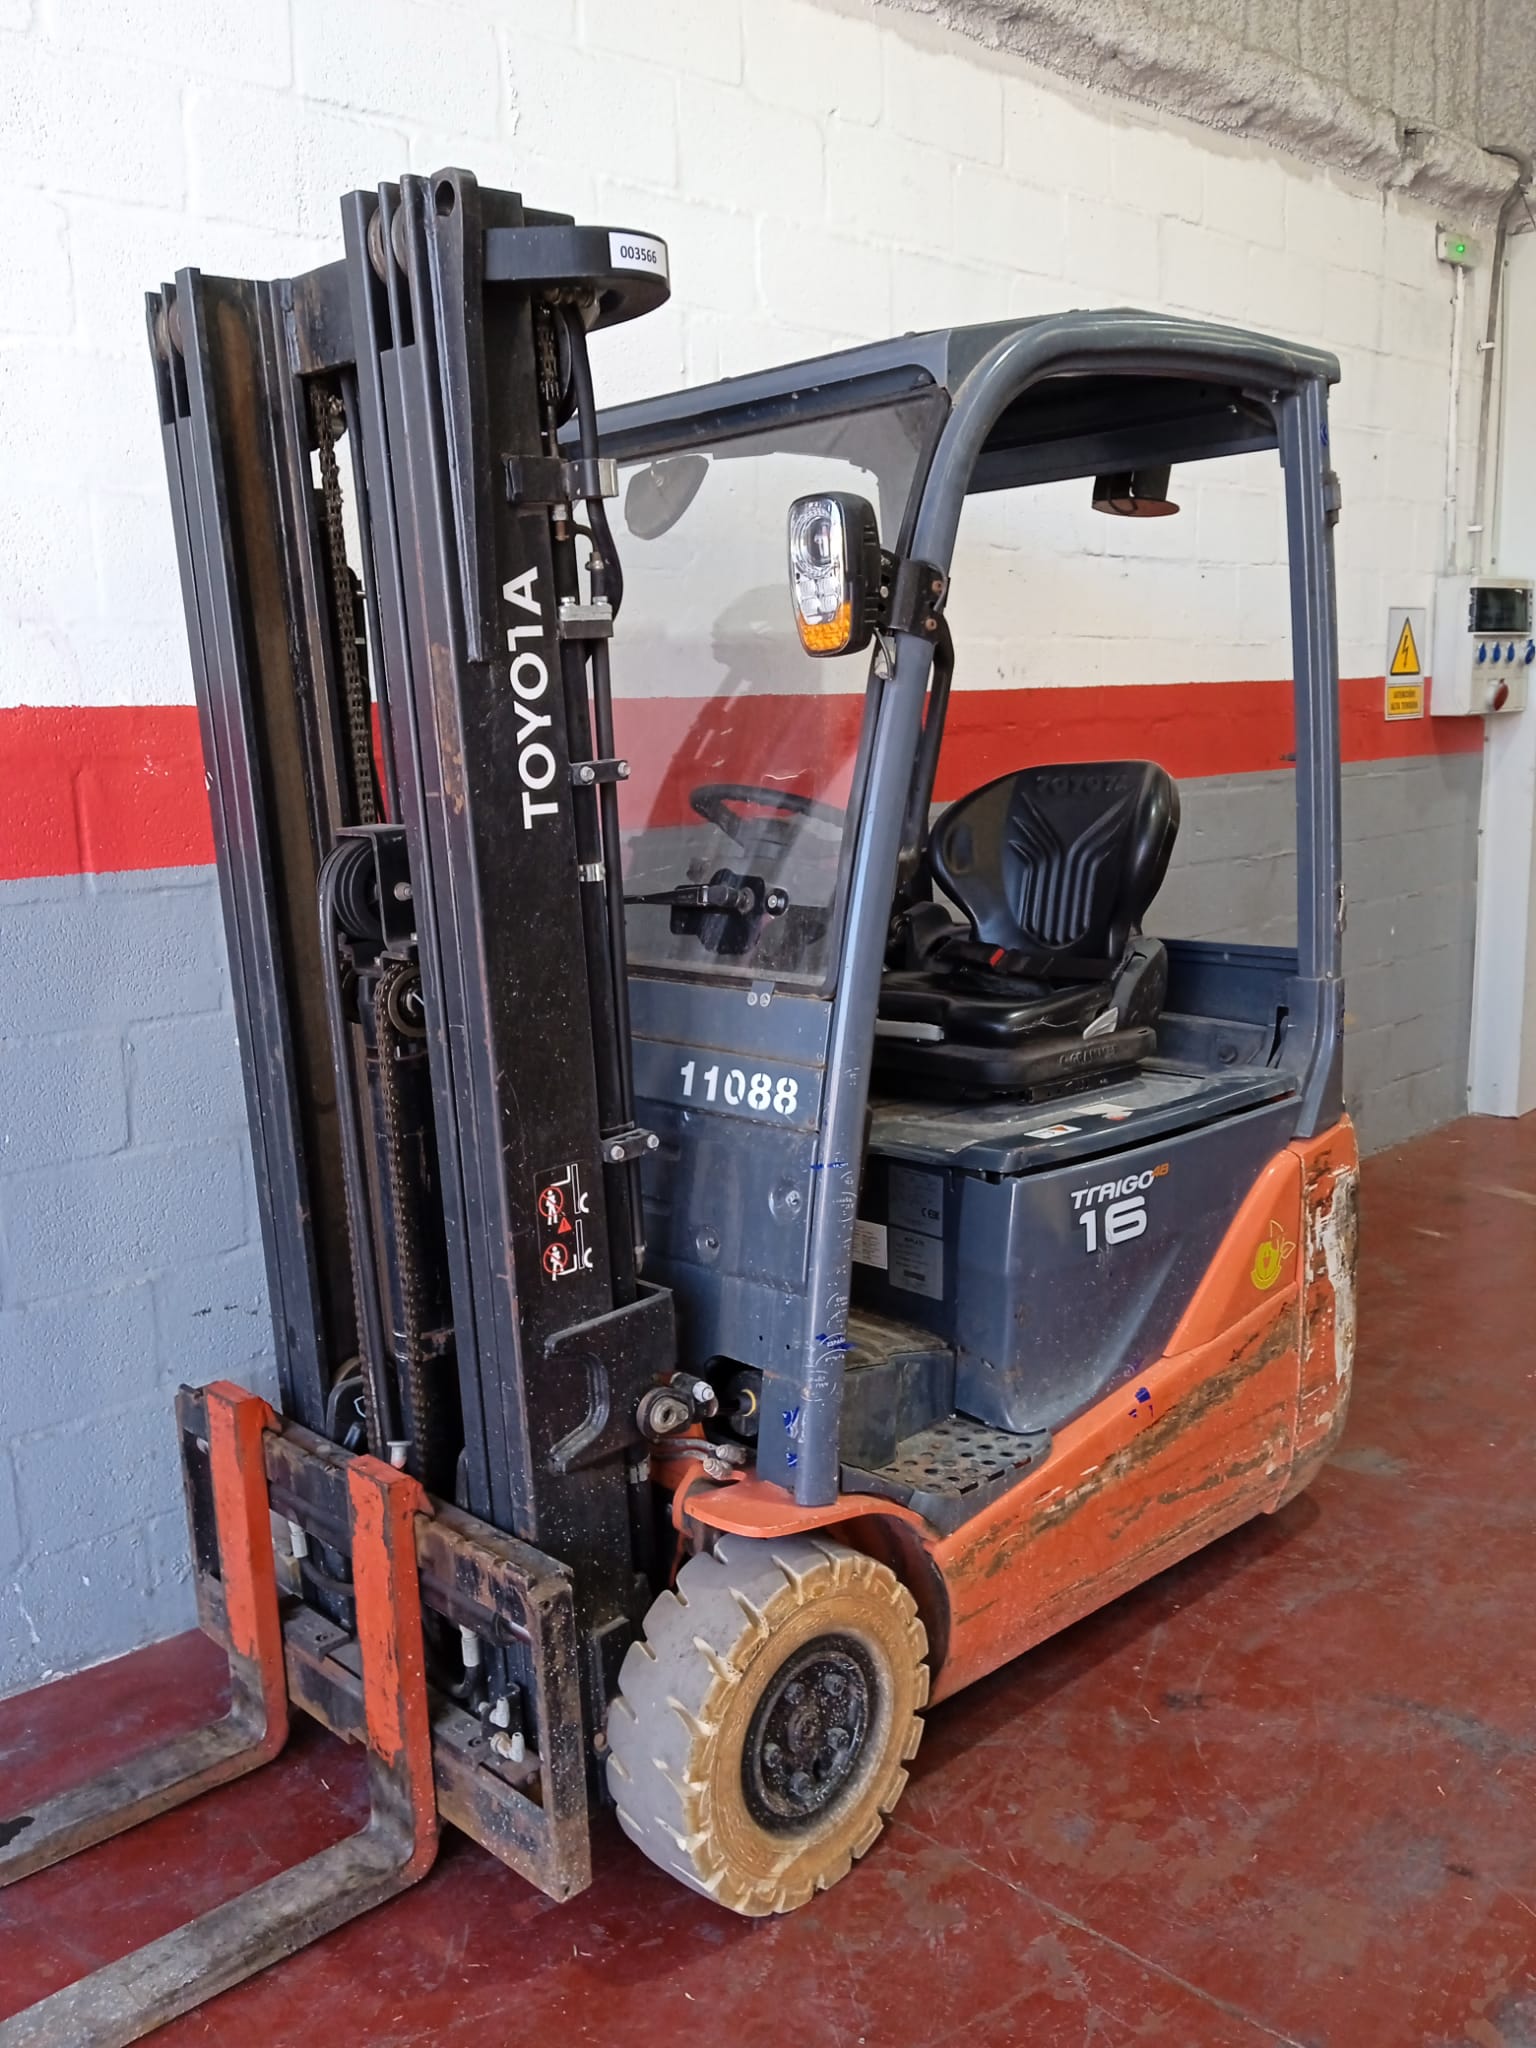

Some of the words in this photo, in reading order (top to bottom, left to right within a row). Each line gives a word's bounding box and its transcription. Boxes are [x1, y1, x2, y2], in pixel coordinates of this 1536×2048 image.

[620, 245, 657, 264] 003566
[680, 1060, 799, 1116] 11088
[1079, 1195, 1147, 1253] 16
